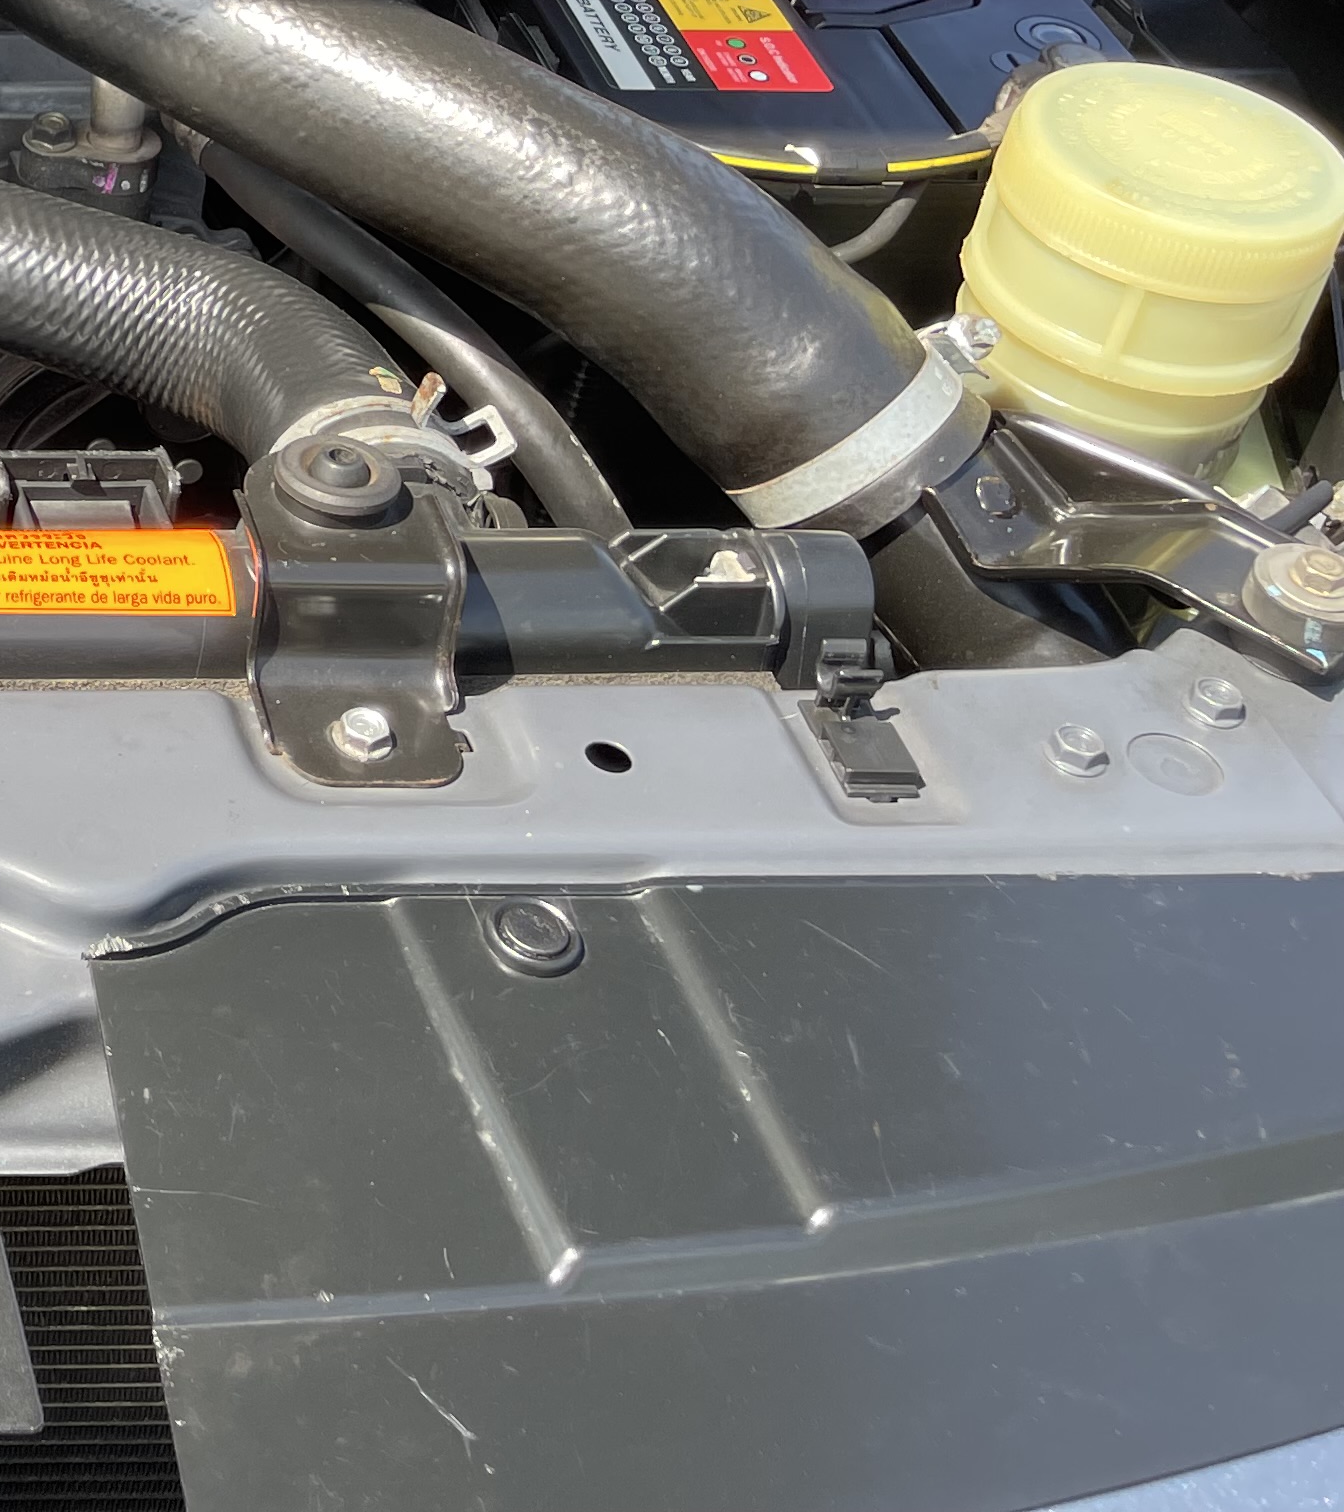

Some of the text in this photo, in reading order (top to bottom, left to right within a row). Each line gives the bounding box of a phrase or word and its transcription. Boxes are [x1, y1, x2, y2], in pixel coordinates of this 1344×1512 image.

[39, 554, 82, 568] Long
[86, 553, 117, 565] Life
[123, 554, 196, 566] Coolant.
[5, 589, 86, 606] refrigerante
[91, 590, 108, 604] de
[113, 591, 147, 607] larga
[152, 591, 180, 604] vida
[186, 592, 222, 607] puro.
